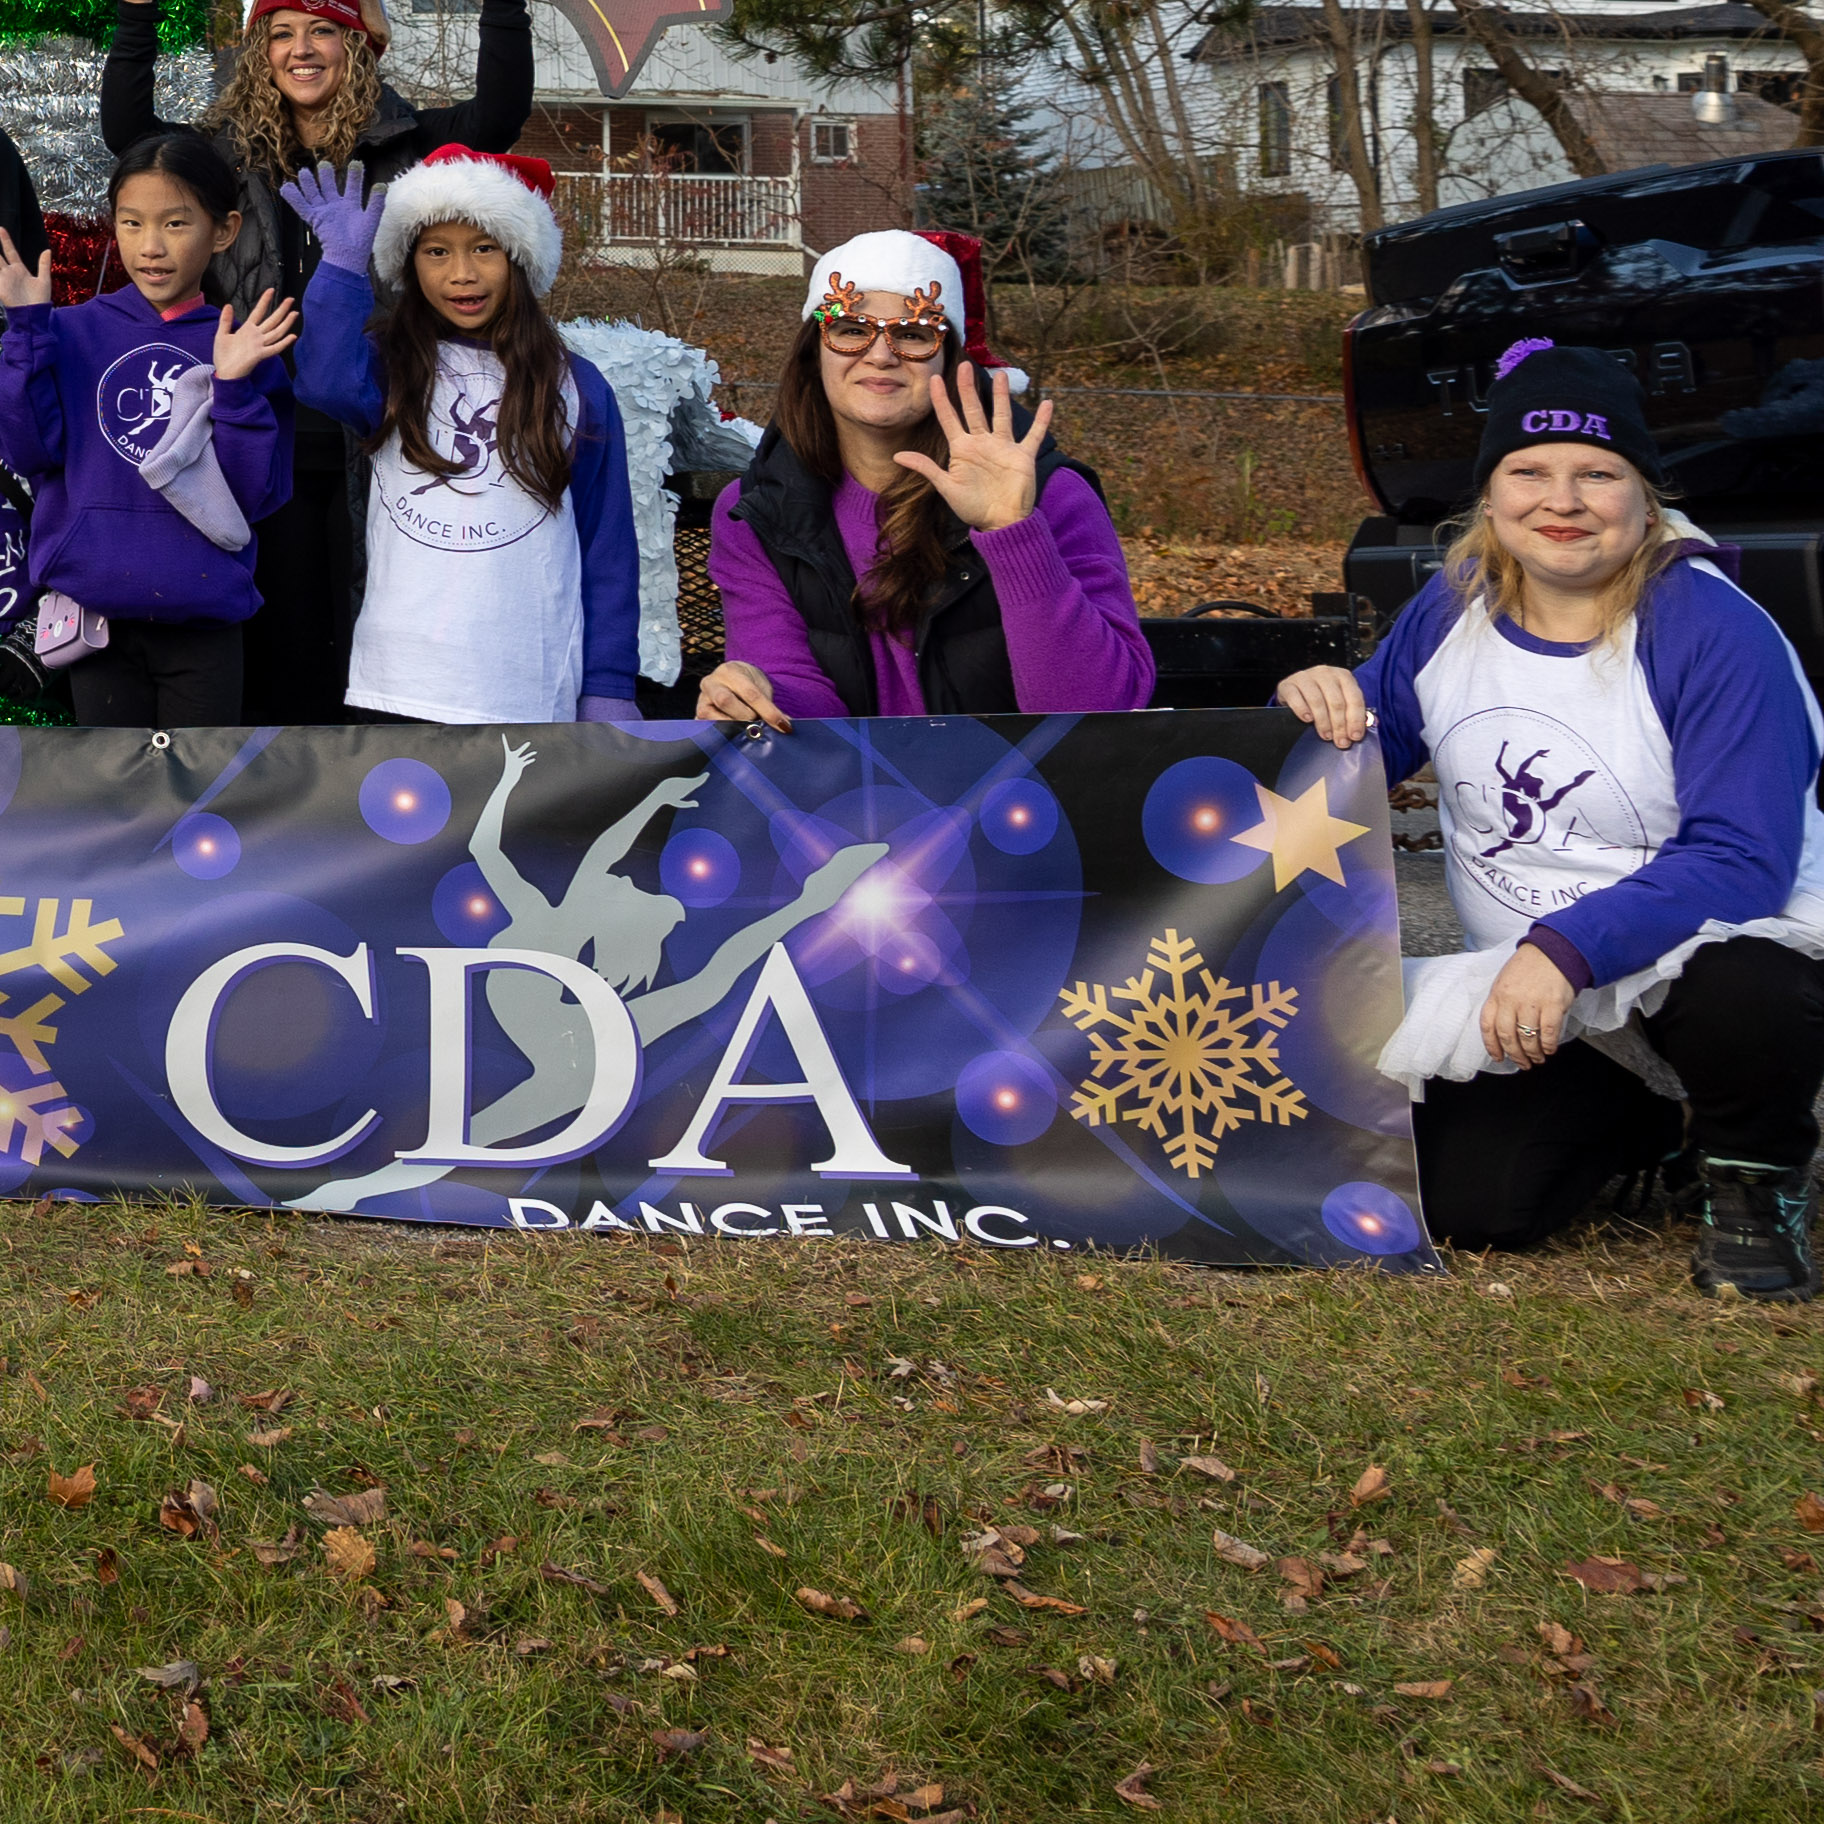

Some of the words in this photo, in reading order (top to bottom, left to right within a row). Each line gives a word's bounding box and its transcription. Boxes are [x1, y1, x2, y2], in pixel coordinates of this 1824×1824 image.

[1521, 409, 1612, 440] CDA
[395, 496, 453, 539] DANCE
[462, 521, 507, 540] INC.
[165, 939, 919, 1181] CDA
[507, 1196, 834, 1236] DANCE
[862, 1200, 1073, 1249] INC.
